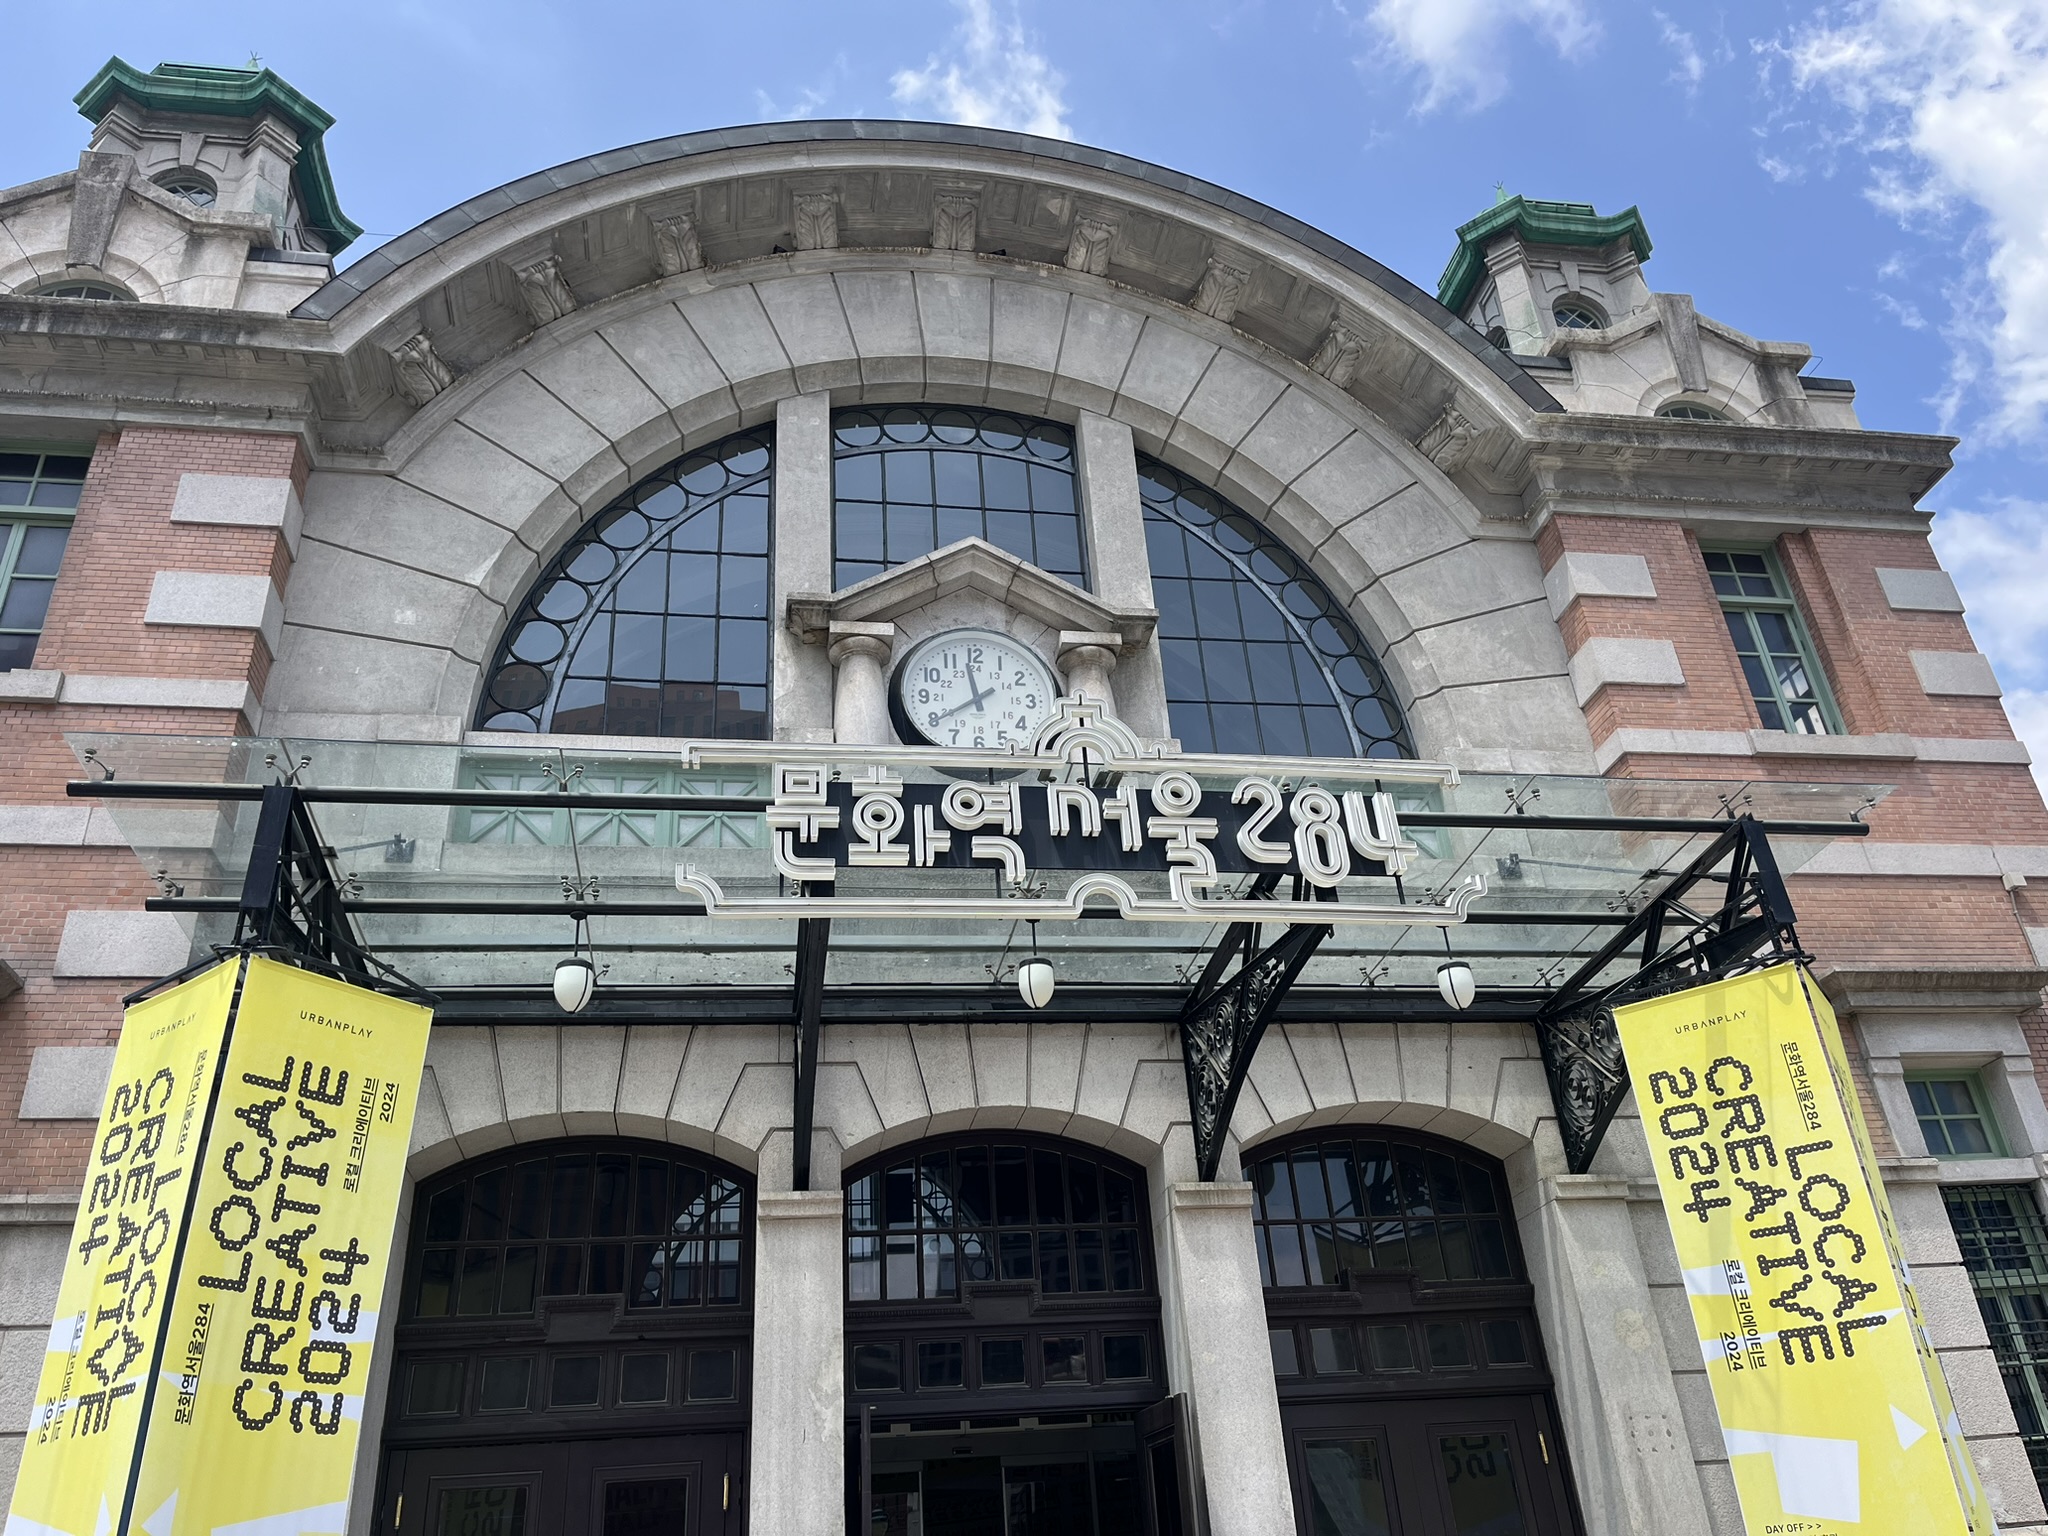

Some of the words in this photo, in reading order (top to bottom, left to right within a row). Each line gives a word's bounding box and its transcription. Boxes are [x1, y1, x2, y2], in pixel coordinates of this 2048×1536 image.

[944, 654, 957, 669] 11
[967, 648, 983, 664] 12
[924, 667, 940, 683] 10
[1014, 671, 1026, 686] 2
[918, 689, 929, 704] 9
[1025, 694, 1036, 709] 3
[928, 712, 939, 727] 8
[973, 726, 984, 734] 18
[1015, 715, 1027, 731] 4
[948, 729, 960, 745] 7
[998, 731, 1007, 746] 5
[150, 1013, 197, 1040] URBANPLAY
[300, 1010, 373, 1039] URBANPLAY
[1675, 1010, 1747, 1034] URBANPLAY
[1783, 1042, 1822, 1130] 문화역서울284
[380, 1082, 396, 1122] 2024
[350, 1077, 376, 1160] 크리에이티브
[1649, 1066, 1732, 1222] 2024
[78, 1078, 143, 1266] 2024
[199, 1055, 296, 1293] LOCAL
[343, 1163, 360, 1193] 로컬
[1706, 1056, 1835, 1366] CREATIVE
[71, 1066, 175, 1439] CREATIVE
[233, 1060, 349, 1432] CREATIVE
[1785, 1140, 1888, 1357] LOCAL
[1726, 1259, 1745, 1285] 로컬
[290, 1237, 369, 1436] 2024
[1734, 1289, 1767, 1369] 크리에이티브
[174, 1303, 211, 1424] 문화역서울284
[1723, 1332, 1744, 1372] 2024
[41, 1397, 56, 1444] 2024
[1765, 1524, 1784, 1534] DAY
[1786, 1523, 1804, 1533] OFF
